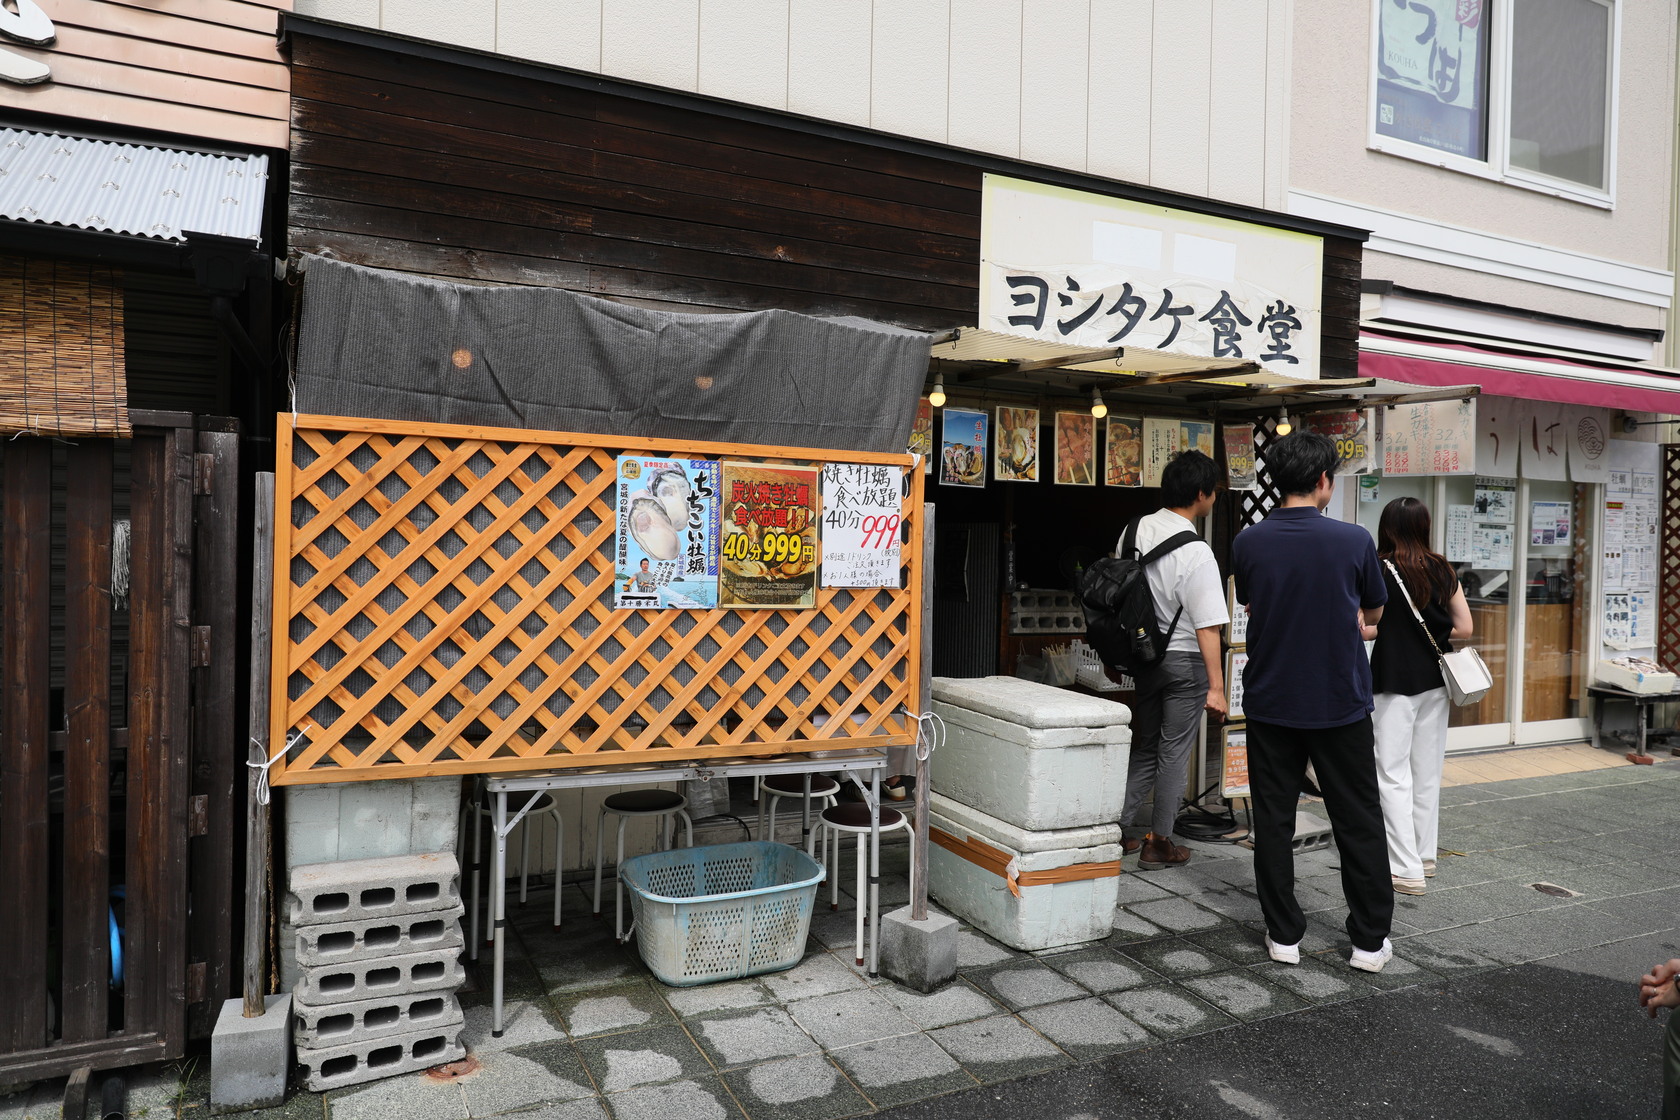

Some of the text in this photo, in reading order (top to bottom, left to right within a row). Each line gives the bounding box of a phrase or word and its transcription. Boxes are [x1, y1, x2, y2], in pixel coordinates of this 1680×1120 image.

[1388, 50, 1418, 70] KOUHA
[1006, 275, 1303, 365] ヨシタケ食堂
[1335, 439, 1364, 459] 99円
[823, 464, 891, 487] 焼き牡蠣
[731, 480, 809, 506] 炭火焼き牡蠣
[834, 485, 898, 509] 食べ放題
[686, 470, 714, 574] ちちこい牡蠣
